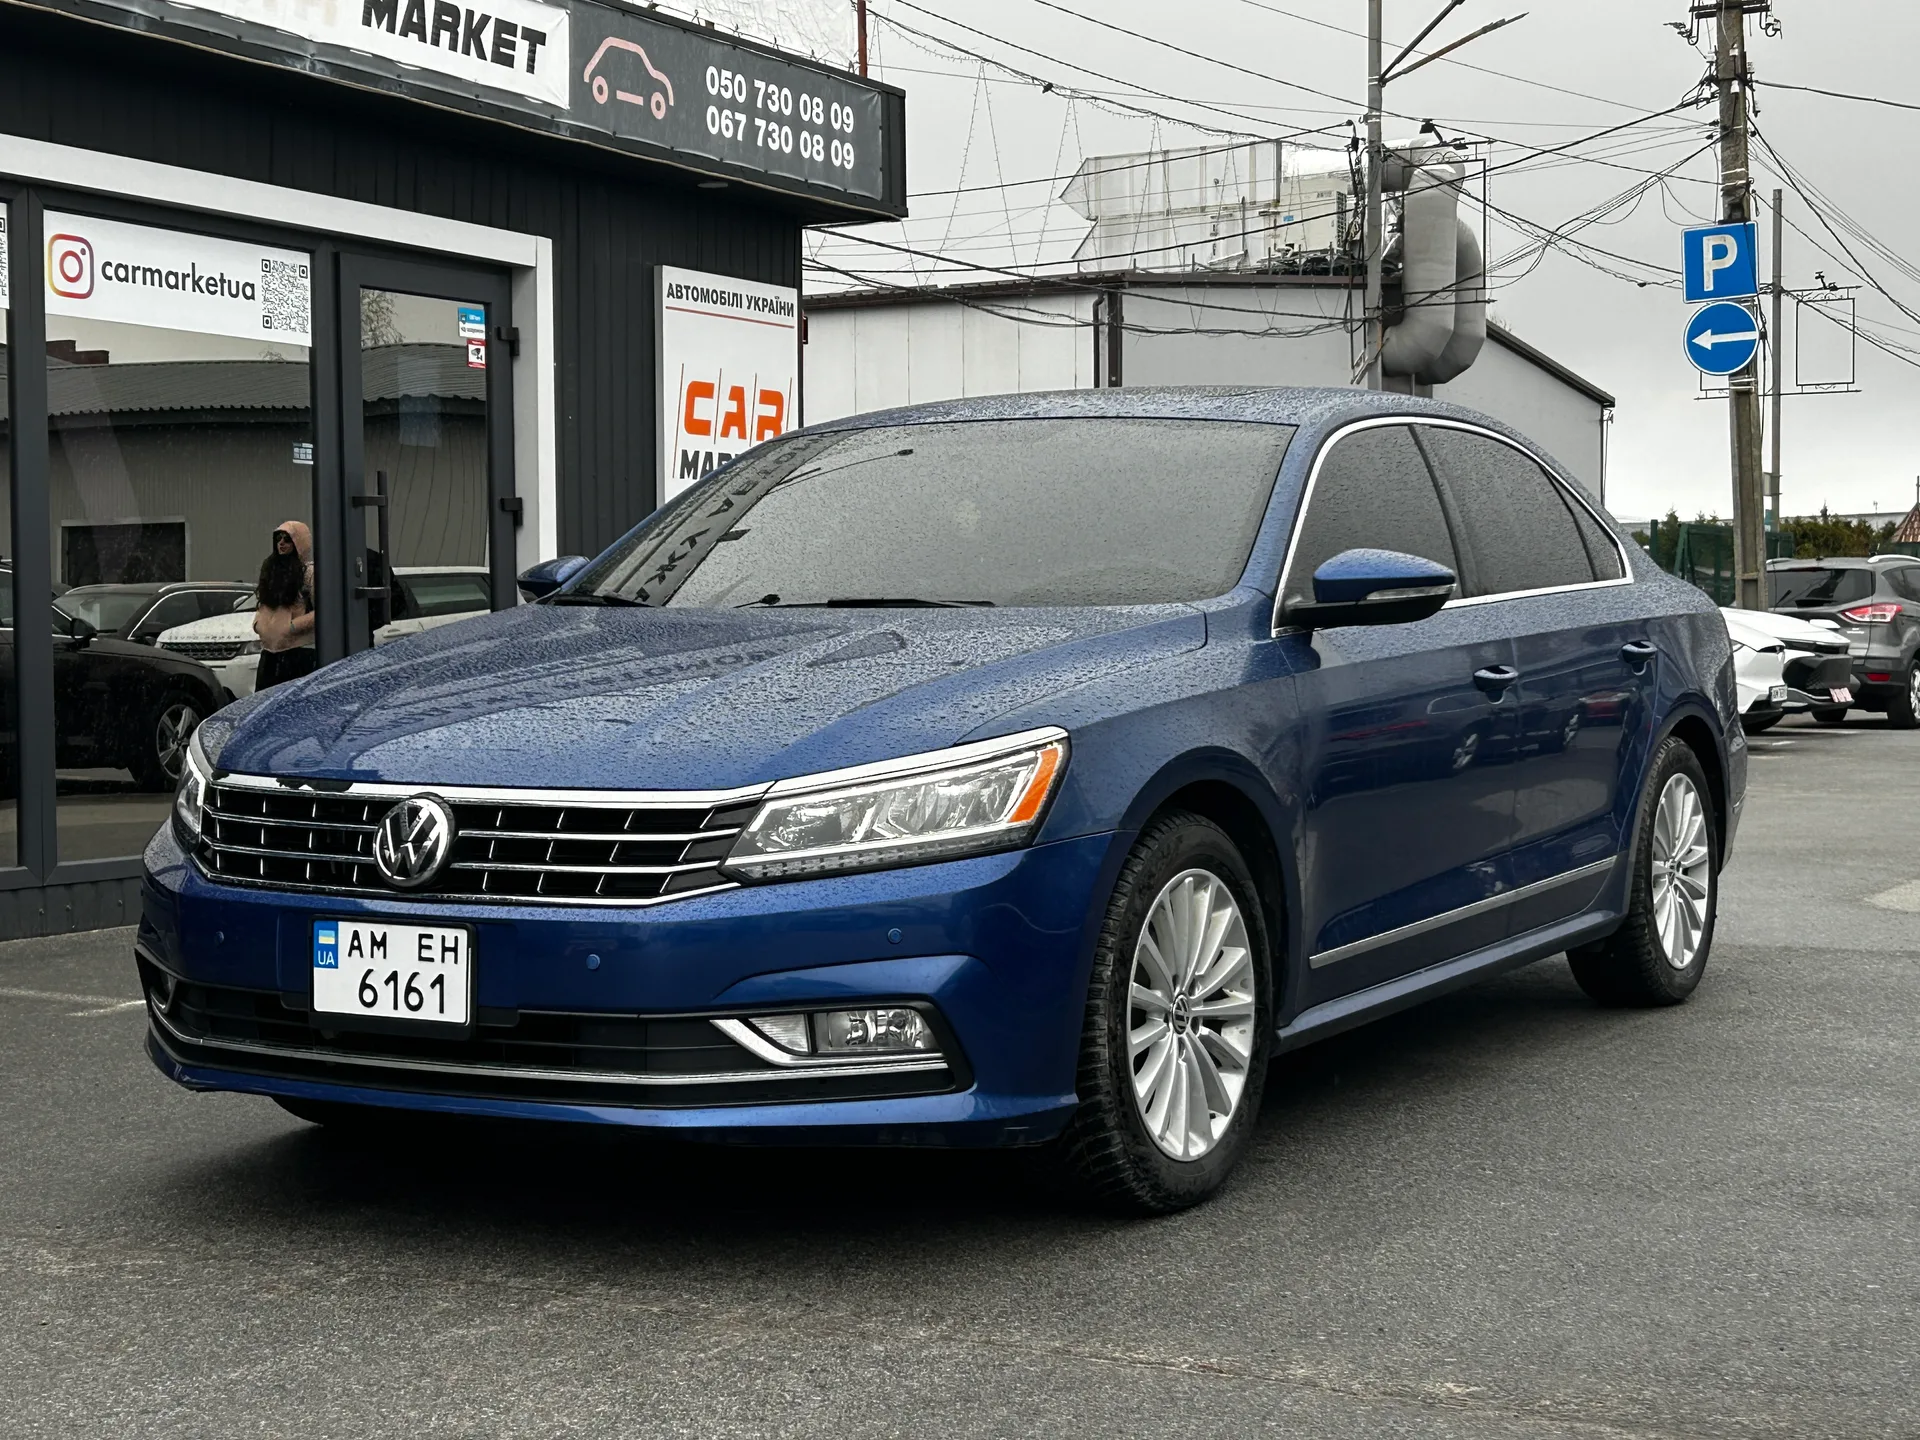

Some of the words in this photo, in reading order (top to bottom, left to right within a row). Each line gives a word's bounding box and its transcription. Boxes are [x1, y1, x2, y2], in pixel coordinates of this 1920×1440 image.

[362, 0, 547, 75] MARKET
[706, 66, 747, 103] 050
[754, 79, 793, 116] 730
[799, 93, 825, 125] 08
[830, 102, 854, 134] 09
[706, 105, 747, 142] 067
[754, 118, 793, 154] 730
[800, 130, 825, 162] 08
[830, 139, 855, 170] 09
[101, 261, 256, 301] carmarketua
[1703, 234, 1738, 292] P
[666, 282, 743, 309] АВТОМОБІЛІ
[746, 294, 795, 318] УКРАЇНИ
[684, 380, 784, 442] CAR
[317, 950, 335, 966] UA
[348, 929, 387, 960] AM
[418, 933, 459, 965] EH
[358, 968, 445, 1014] 6161
